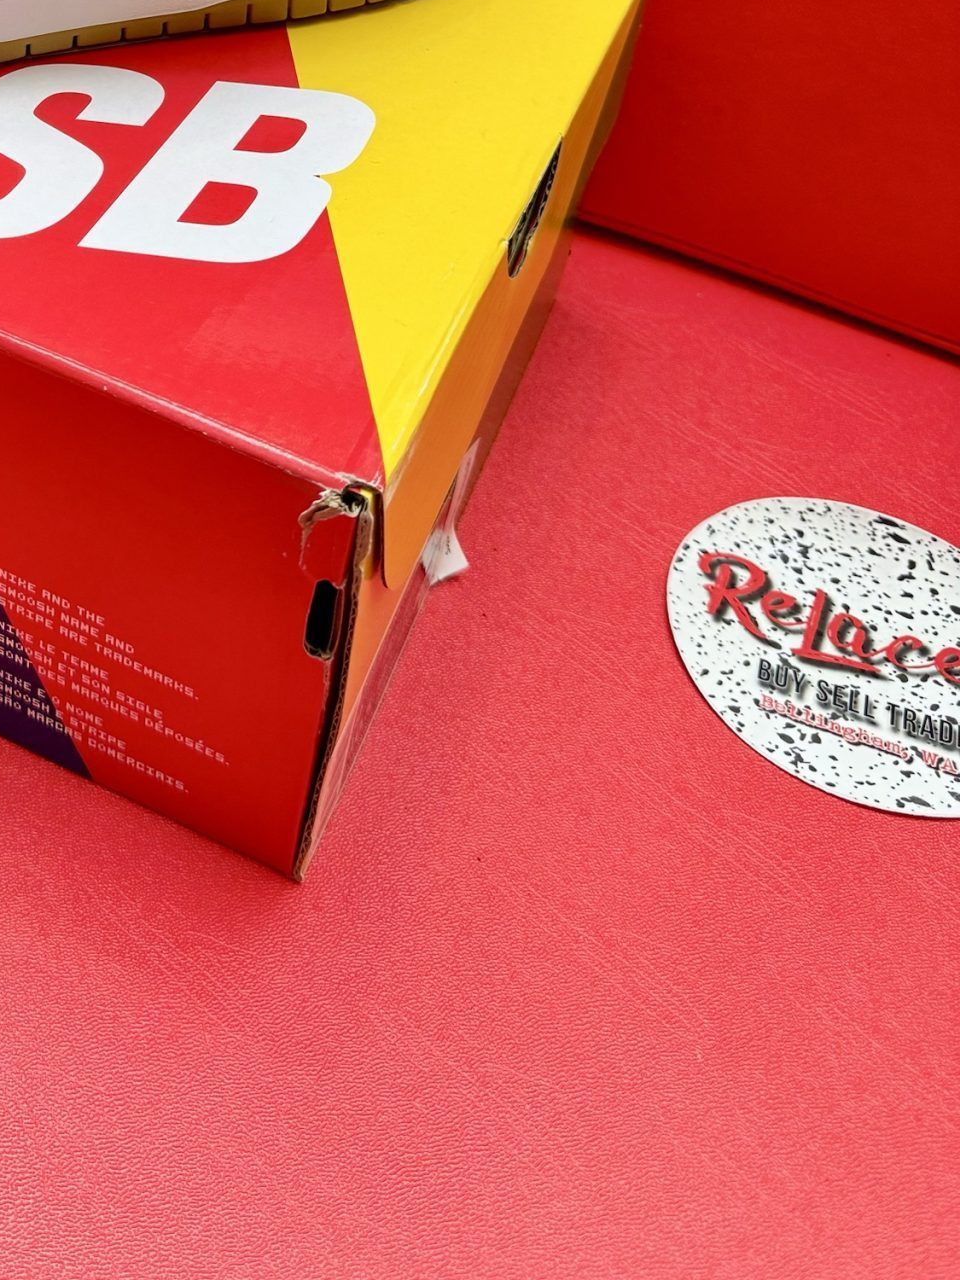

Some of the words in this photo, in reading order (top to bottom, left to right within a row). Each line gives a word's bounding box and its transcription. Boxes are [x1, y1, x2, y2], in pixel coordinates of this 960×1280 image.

[42, 588, 70, 609] AND
[76, 605, 105, 627] THE
[60, 611, 99, 637] NAME
[105, 633, 134, 654] AND
[40, 639, 56, 655] LE
[60, 625, 88, 646] ARE
[94, 641, 199, 700] TRADEMARKS.
[37, 687, 46, 699] E
[51, 695, 60, 705] O
[65, 701, 103, 727] NOME
[38, 665, 66, 686] DES
[71, 681, 139, 722] MARQUES
[144, 718, 230, 766] DÉPOSÉES.
[58, 662, 76, 678] ET
[81, 673, 110, 695] SON
[116, 689, 163, 720] SIGLE
[758, 658, 806, 693] BUY
[816, 679, 875, 719] SELL
[888, 702, 960, 747] TRAD
[27, 707, 82, 742] MARCAS
[87, 737, 189, 793] COMERCIAIS.
[55, 709, 64, 720] E
[69, 716, 127, 750] STRIPE
[759, 693, 911, 761] Bellingham,
[921, 749, 958, 774] WA
